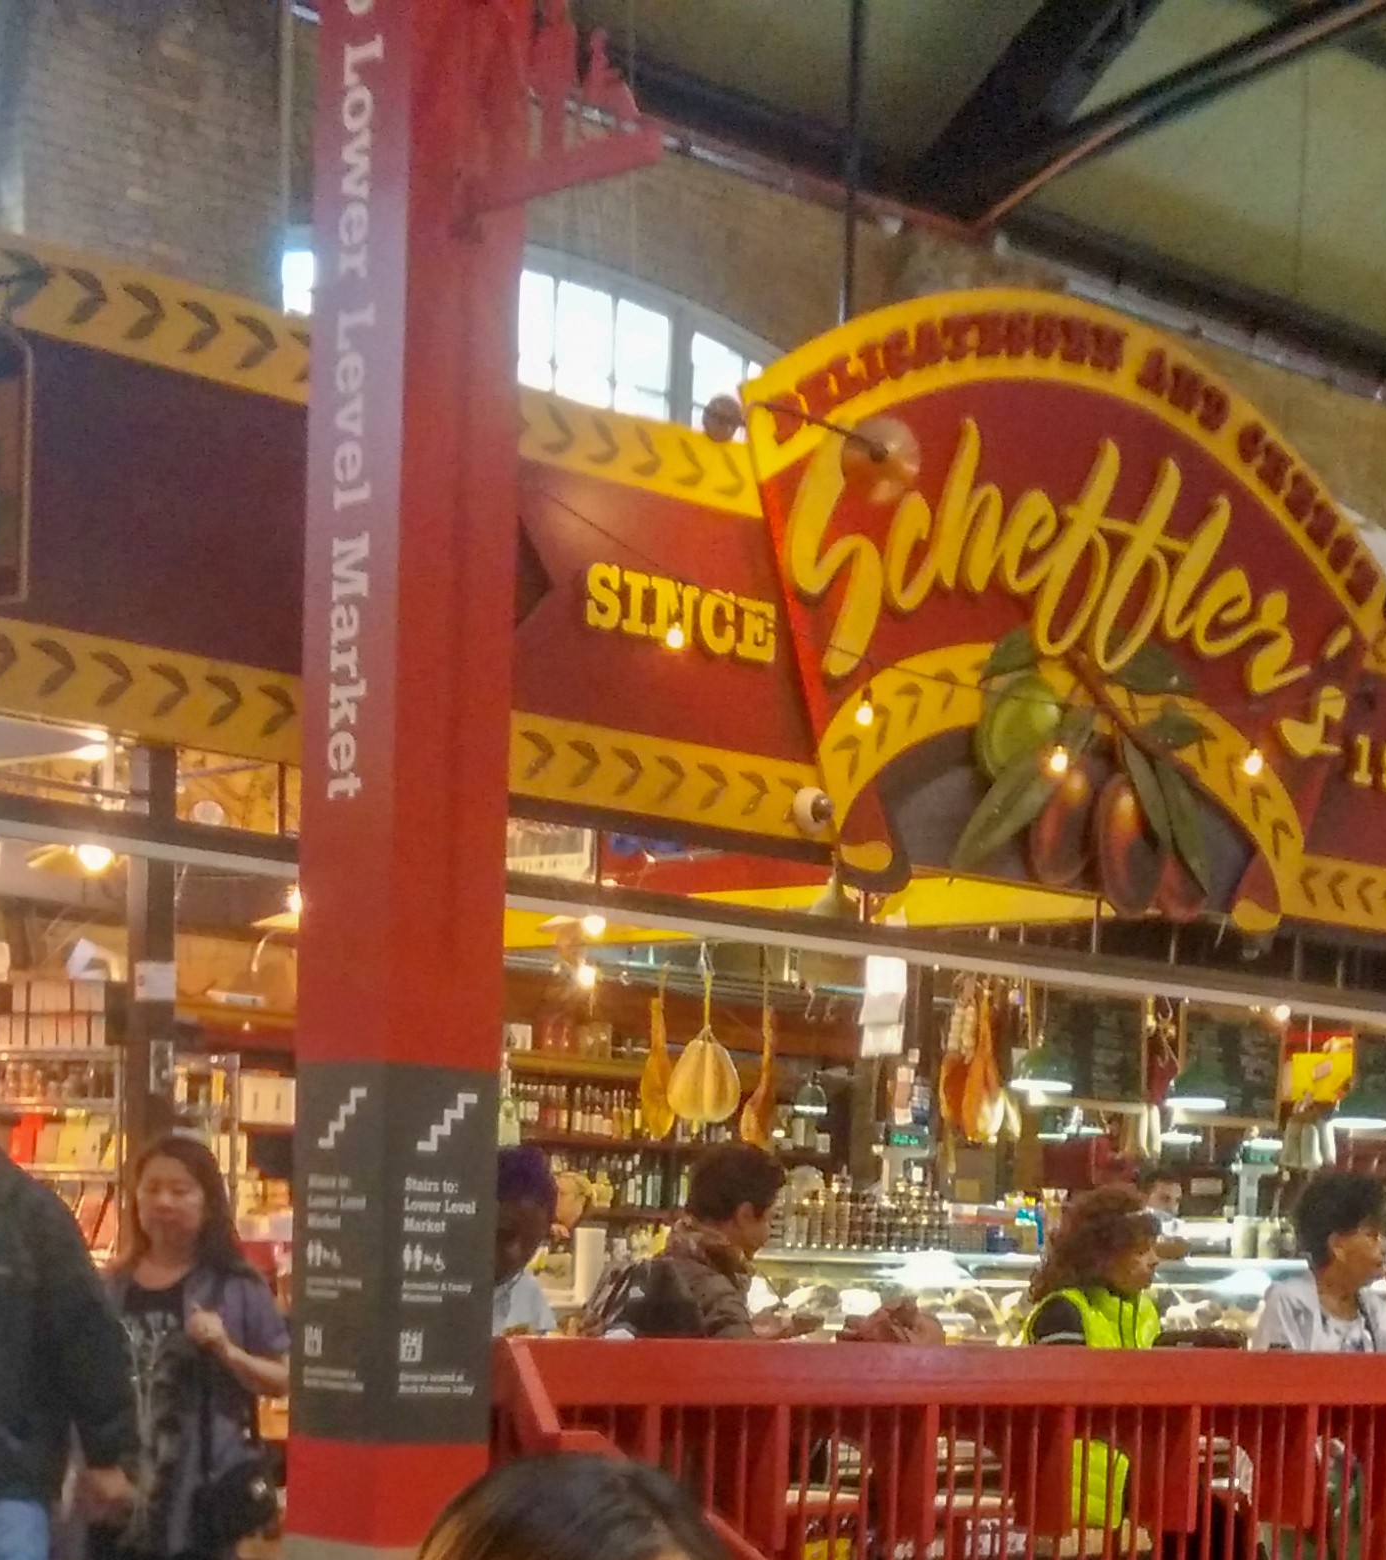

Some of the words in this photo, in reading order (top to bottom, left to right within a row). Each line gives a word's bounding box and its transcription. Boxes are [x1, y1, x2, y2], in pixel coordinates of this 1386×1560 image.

[339, 33, 385, 279] Lower
[333, 301, 377, 512] Level
[1135, 345, 1232, 432] AND
[586, 561, 776, 664] SINCE
[326, 530, 371, 801] Market
[403, 1196, 442, 1213] Lower
[444, 1200, 477, 1215] Level
[403, 1216, 446, 1233] Market
[404, 1176, 440, 1193] Stairs
